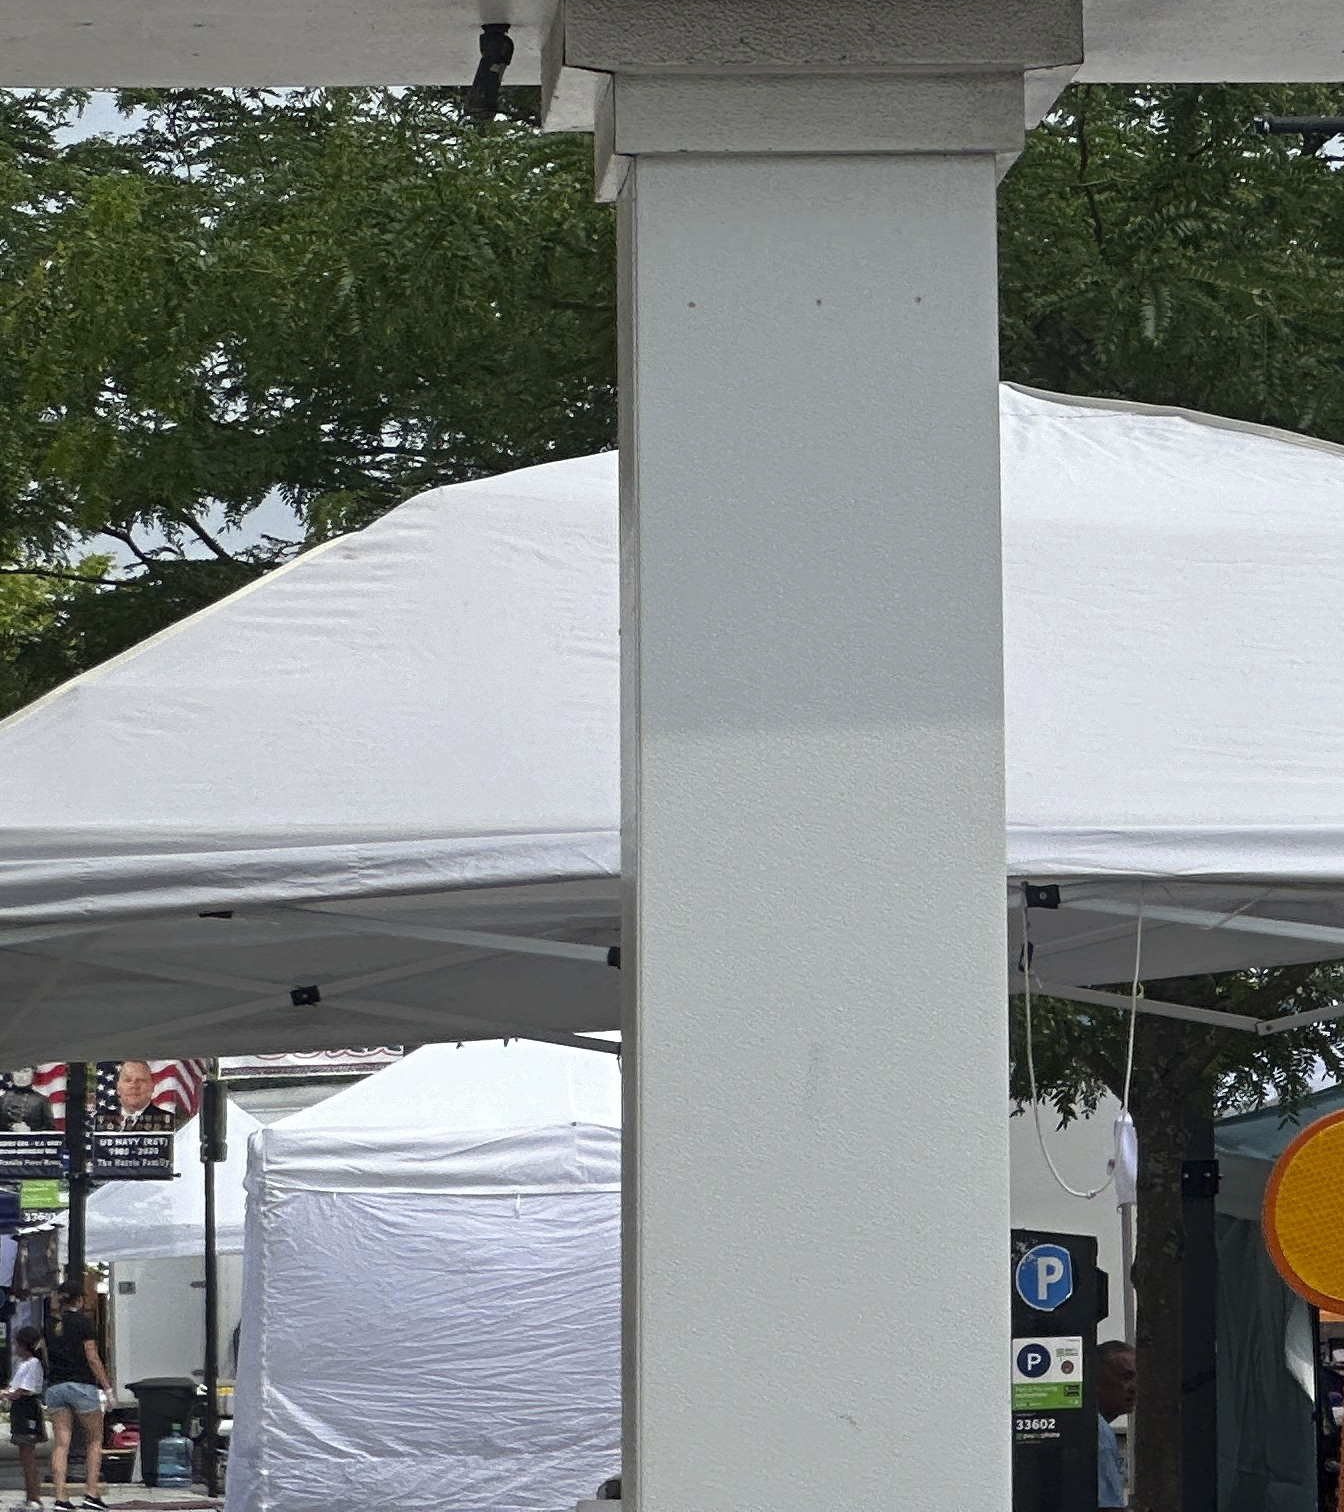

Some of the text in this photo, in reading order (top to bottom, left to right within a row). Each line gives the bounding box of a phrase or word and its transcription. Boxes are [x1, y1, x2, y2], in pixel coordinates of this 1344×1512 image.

[1036, 1256, 1064, 1300] P
[1026, 1352, 1042, 1371] P
[1016, 1418, 1056, 1431] 33602
